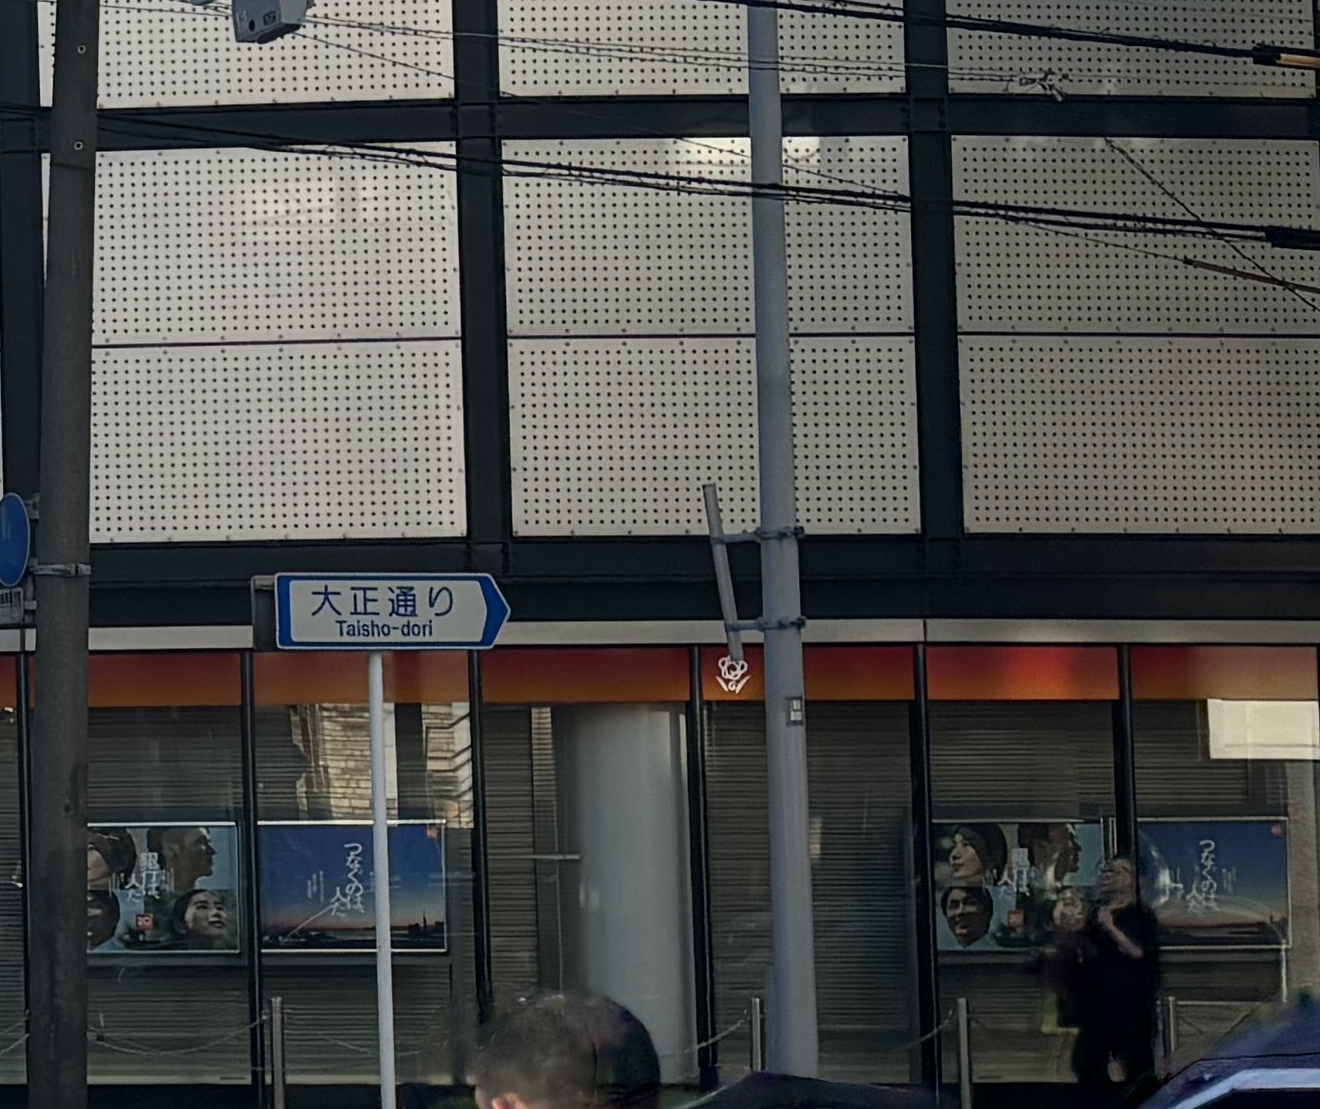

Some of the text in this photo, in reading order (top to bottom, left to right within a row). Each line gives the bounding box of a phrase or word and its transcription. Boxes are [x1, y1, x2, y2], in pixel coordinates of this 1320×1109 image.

[311, 584, 454, 617] 大正通り
[335, 620, 432, 637] Taisho-dori
